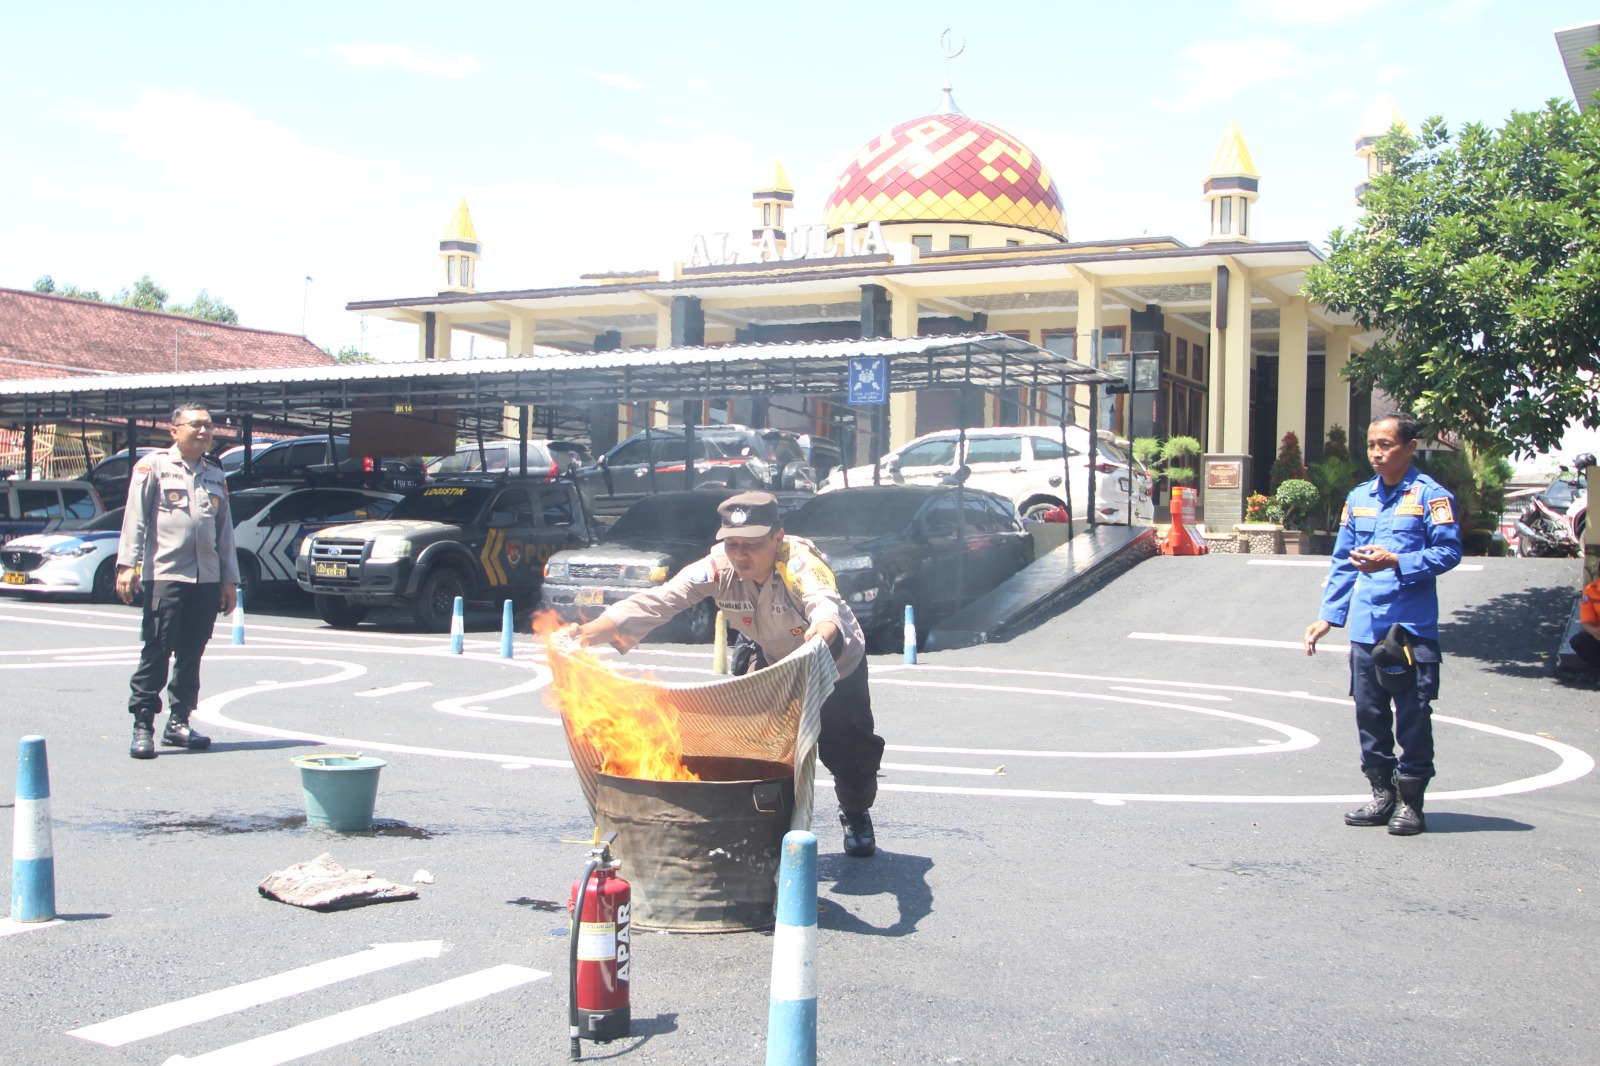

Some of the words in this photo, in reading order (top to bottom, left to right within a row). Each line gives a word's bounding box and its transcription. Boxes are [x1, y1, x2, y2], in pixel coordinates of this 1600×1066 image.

[685, 232, 739, 268] AL
[757, 220, 889, 263] AULIA
[423, 487, 467, 496] LOGISTIK
[617, 901, 630, 981] APAR
